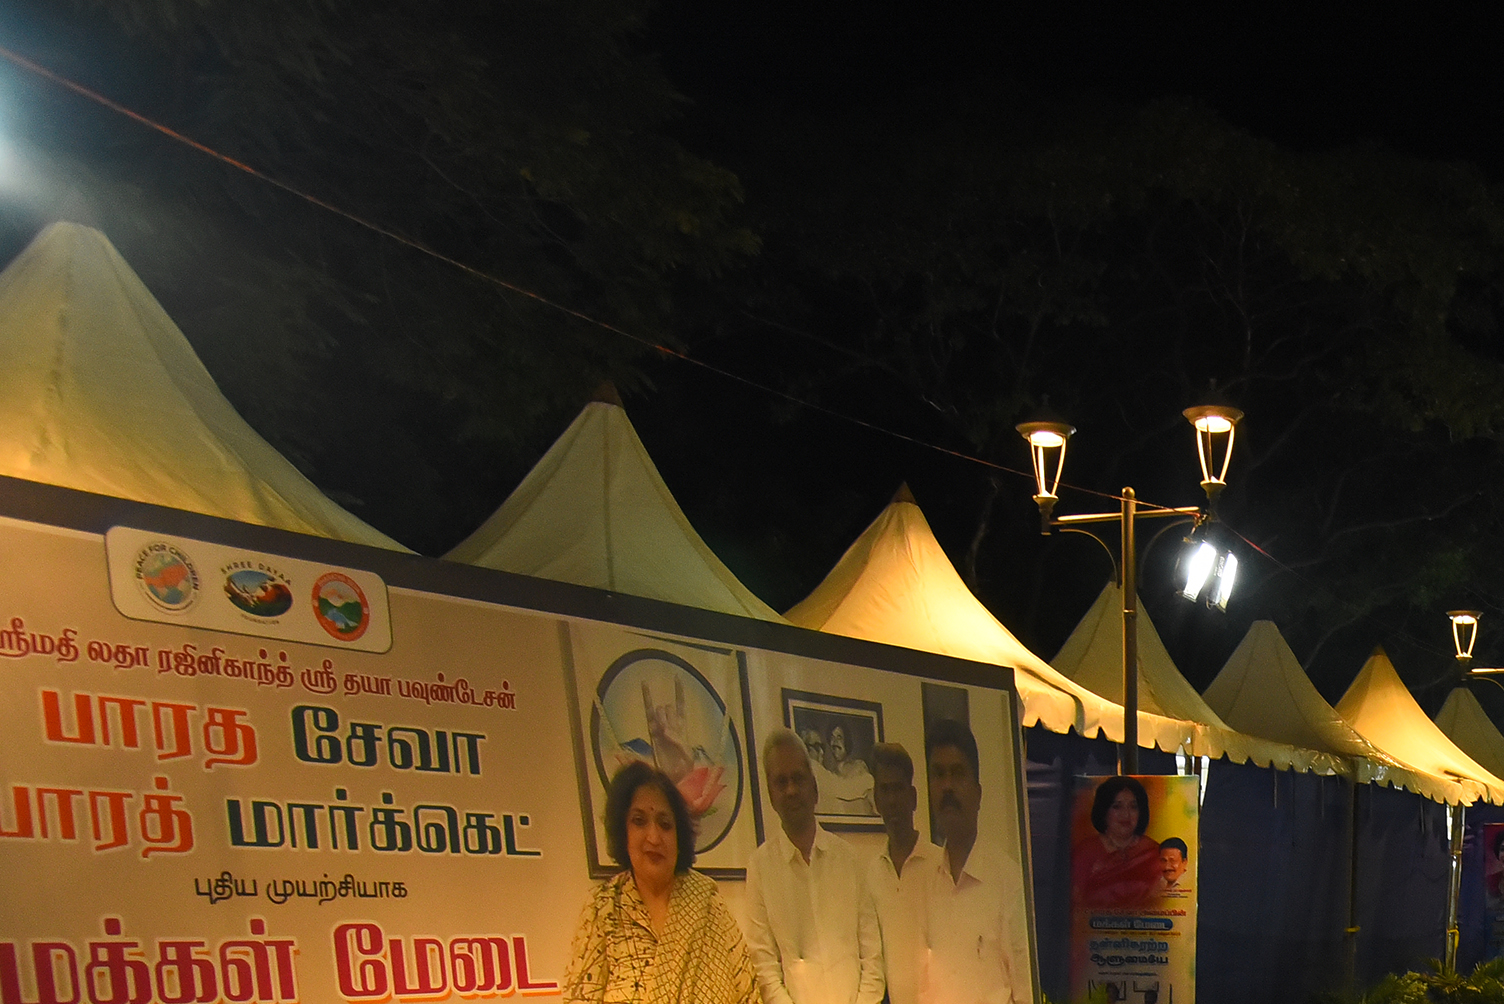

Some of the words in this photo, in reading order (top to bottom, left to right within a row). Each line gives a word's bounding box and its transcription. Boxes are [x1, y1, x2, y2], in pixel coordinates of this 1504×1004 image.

[136, 547, 150, 580] PEACE
[148, 542, 168, 556] FOR
[168, 543, 201, 592] CHILDREN
[220, 560, 252, 575] SHREE
[258, 562, 292, 587] DAYAA
[87, 639, 149, 670] லதா
[157, 643, 295, 688] ரஜினிகாந்த்
[301, 659, 337, 694] ஸ்ரீ
[343, 673, 392, 696] தயா
[397, 671, 516, 710] பவுண்டேசன்
[42, 690, 258, 769] பாரத
[290, 704, 487, 776] சேவா
[0, 776, 194, 858] பாரத்
[227, 787, 542, 857] மார்க்கெட்
[195, 871, 257, 905] புதிய
[266, 874, 408, 905] முயற்சியாக
[333, 922, 561, 1002] மேடை
